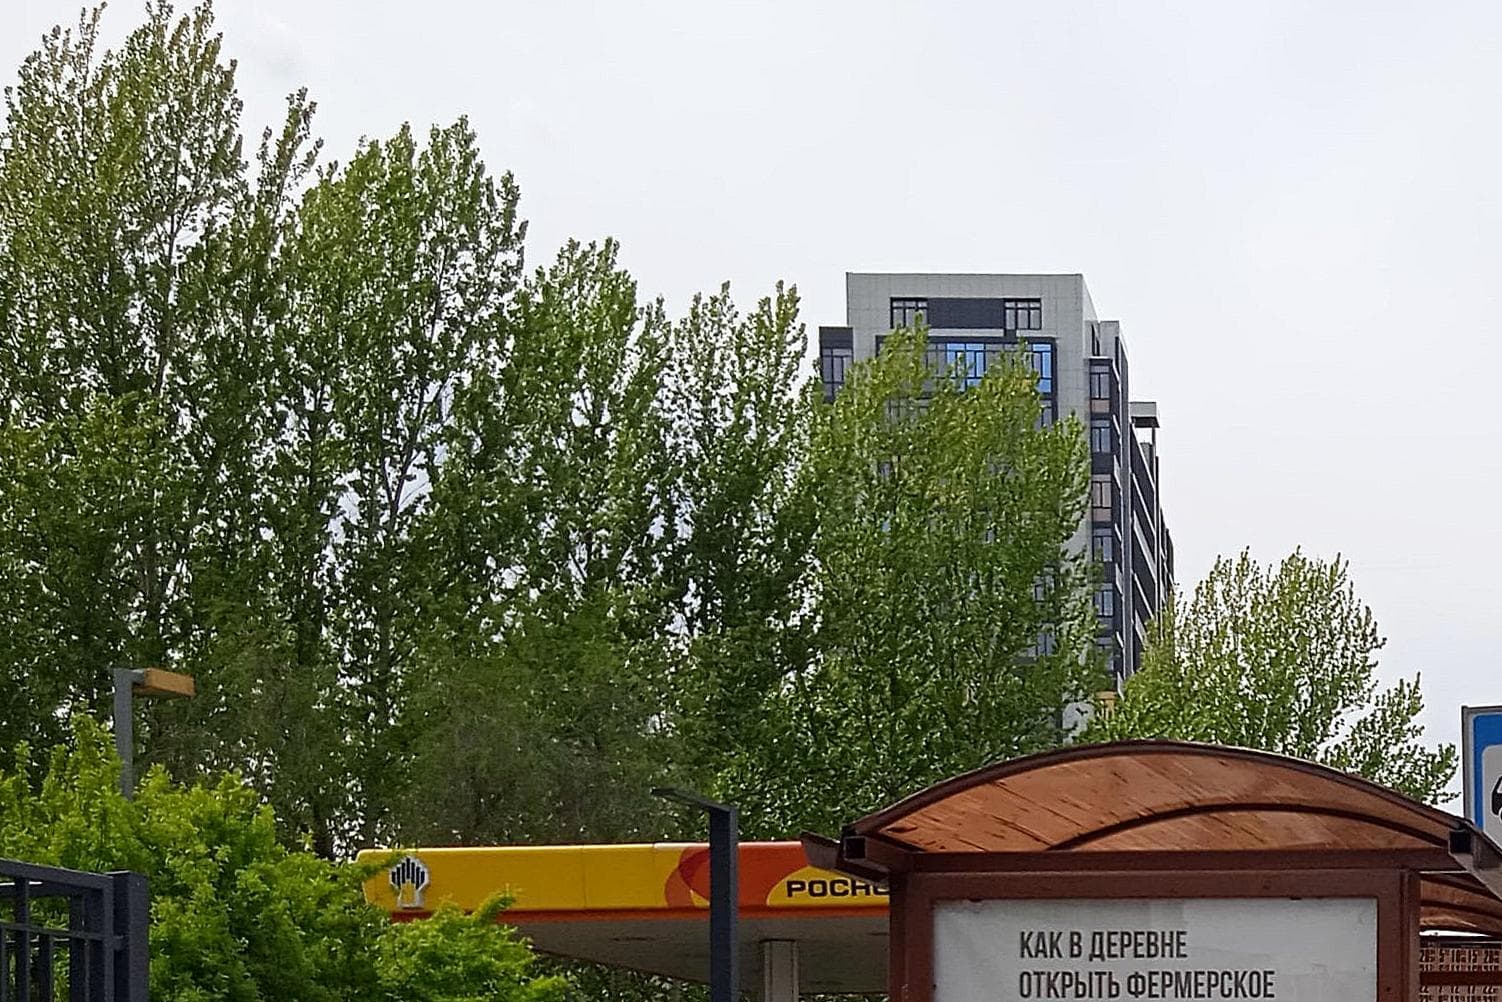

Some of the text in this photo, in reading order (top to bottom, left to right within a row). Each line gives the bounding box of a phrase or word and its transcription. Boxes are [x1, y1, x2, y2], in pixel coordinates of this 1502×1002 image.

[1019, 930, 1188, 962] КАК В ДЕРЕВНЕ
[1019, 970, 1275, 999] ОТКРЫТЬ ФЕРМЕРСКОЕ
